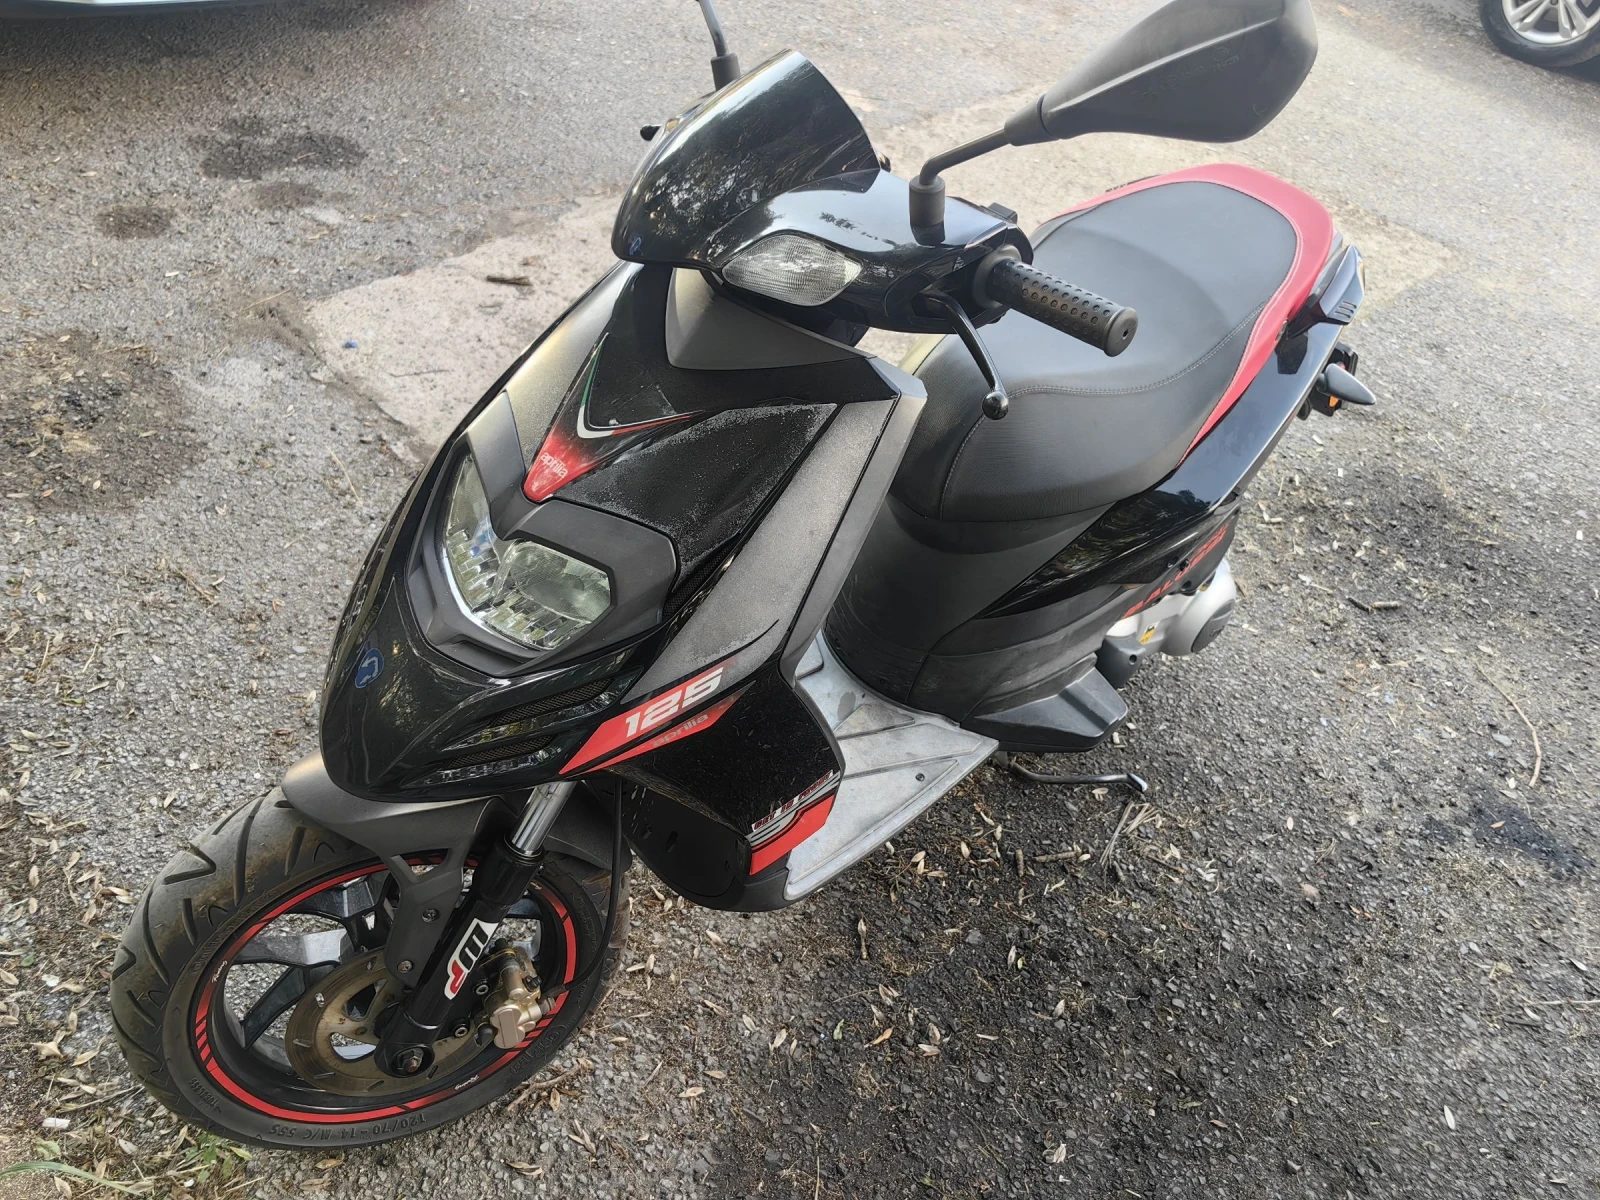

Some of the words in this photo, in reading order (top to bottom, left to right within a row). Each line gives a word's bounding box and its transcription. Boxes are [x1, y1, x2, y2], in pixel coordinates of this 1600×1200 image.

[540, 452, 569, 479] aprilia
[624, 667, 724, 738] 125
[652, 712, 709, 748] aprilia
